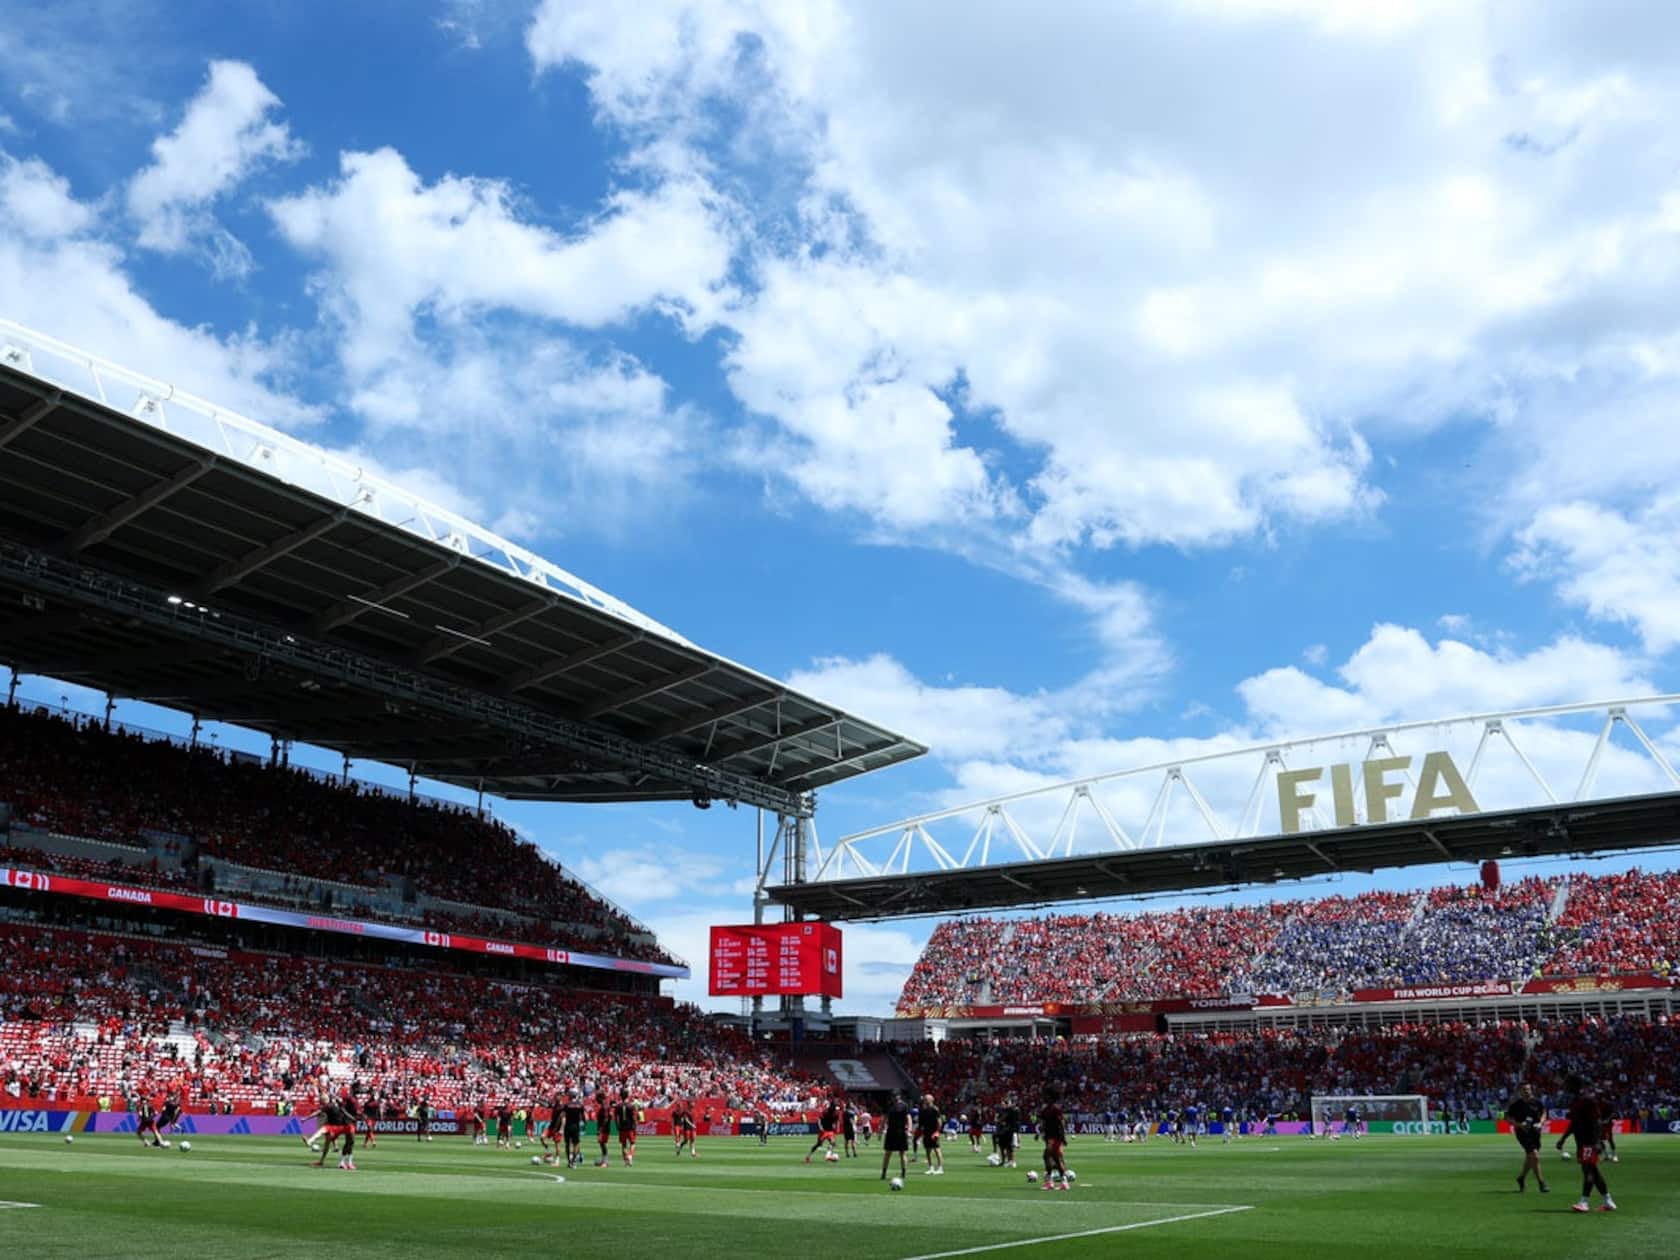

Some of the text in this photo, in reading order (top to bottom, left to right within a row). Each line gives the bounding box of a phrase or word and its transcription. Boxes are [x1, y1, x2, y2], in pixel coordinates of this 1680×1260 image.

[1277, 751, 1480, 833] FIFA
[108, 887, 151, 902] CANADA
[1394, 989, 1415, 999] FIFA
[1415, 987, 1451, 998] WORLD
[1452, 986, 1472, 995] CUP
[1189, 998, 1259, 1008] TOROO
[0, 1111, 49, 1131] VISA
[1393, 1121, 1470, 1134] aramco
